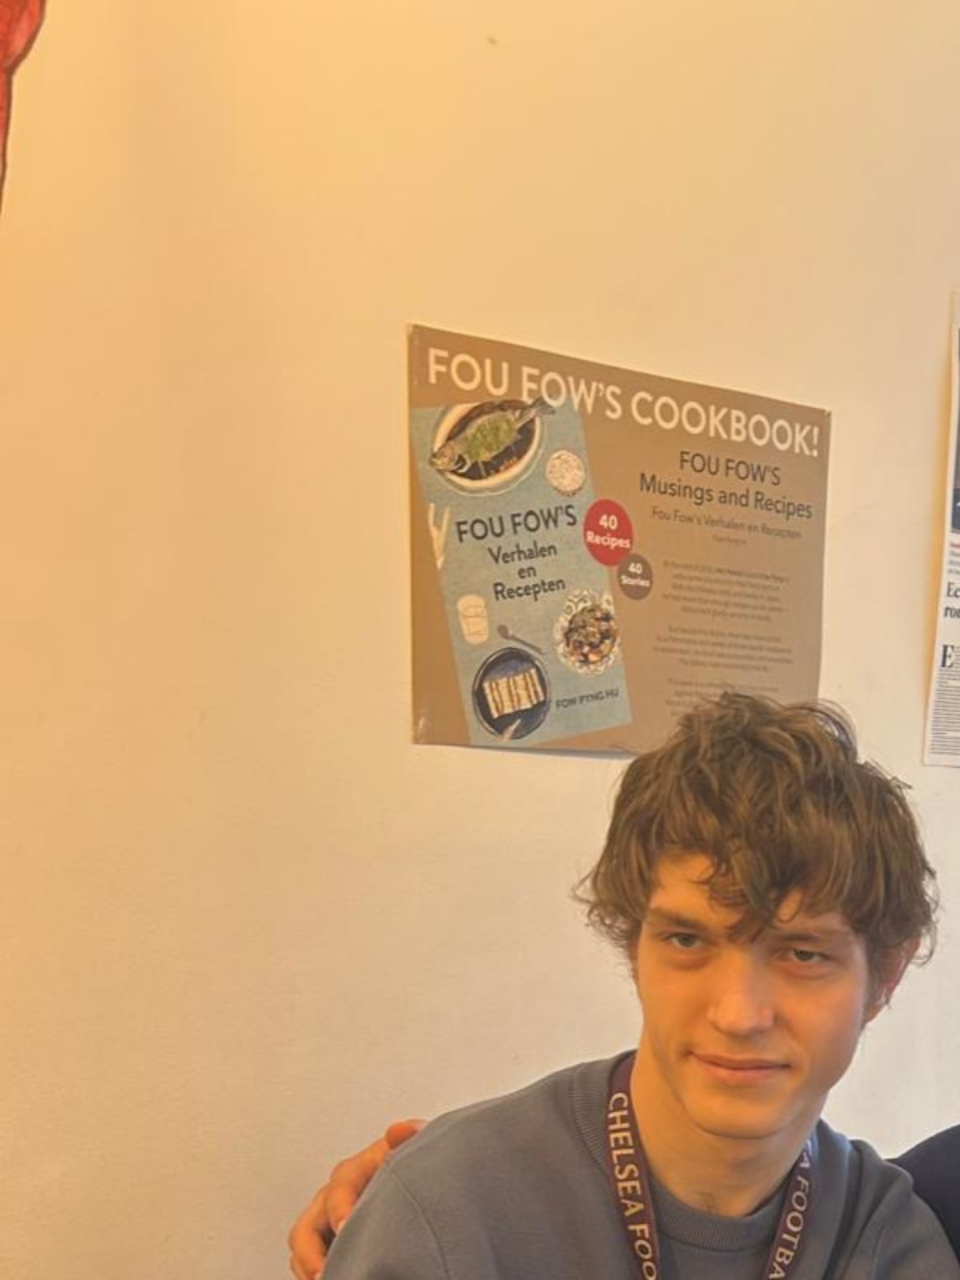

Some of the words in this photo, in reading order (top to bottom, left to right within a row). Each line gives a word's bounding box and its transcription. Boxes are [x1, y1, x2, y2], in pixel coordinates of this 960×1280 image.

[427, 347, 510, 396] FOU
[521, 366, 624, 420] FOW'S
[630, 391, 821, 457] COOKBOOK!
[678, 450, 720, 475] FOU
[724, 459, 782, 486] FOW'S
[638, 472, 716, 508] Musings
[717, 486, 751, 508] and
[753, 493, 813, 521] Recipes
[456, 515, 505, 543] FOU
[511, 504, 579, 536] FOW'S
[598, 513, 620, 531] 40
[487, 543, 558, 566] Verhalen
[586, 531, 631, 552] Recipes
[518, 565, 537, 579] en
[628, 562, 643, 574] 40
[493, 577, 566, 603] Recepten
[608, 1092, 645, 1217] CHELSEA
